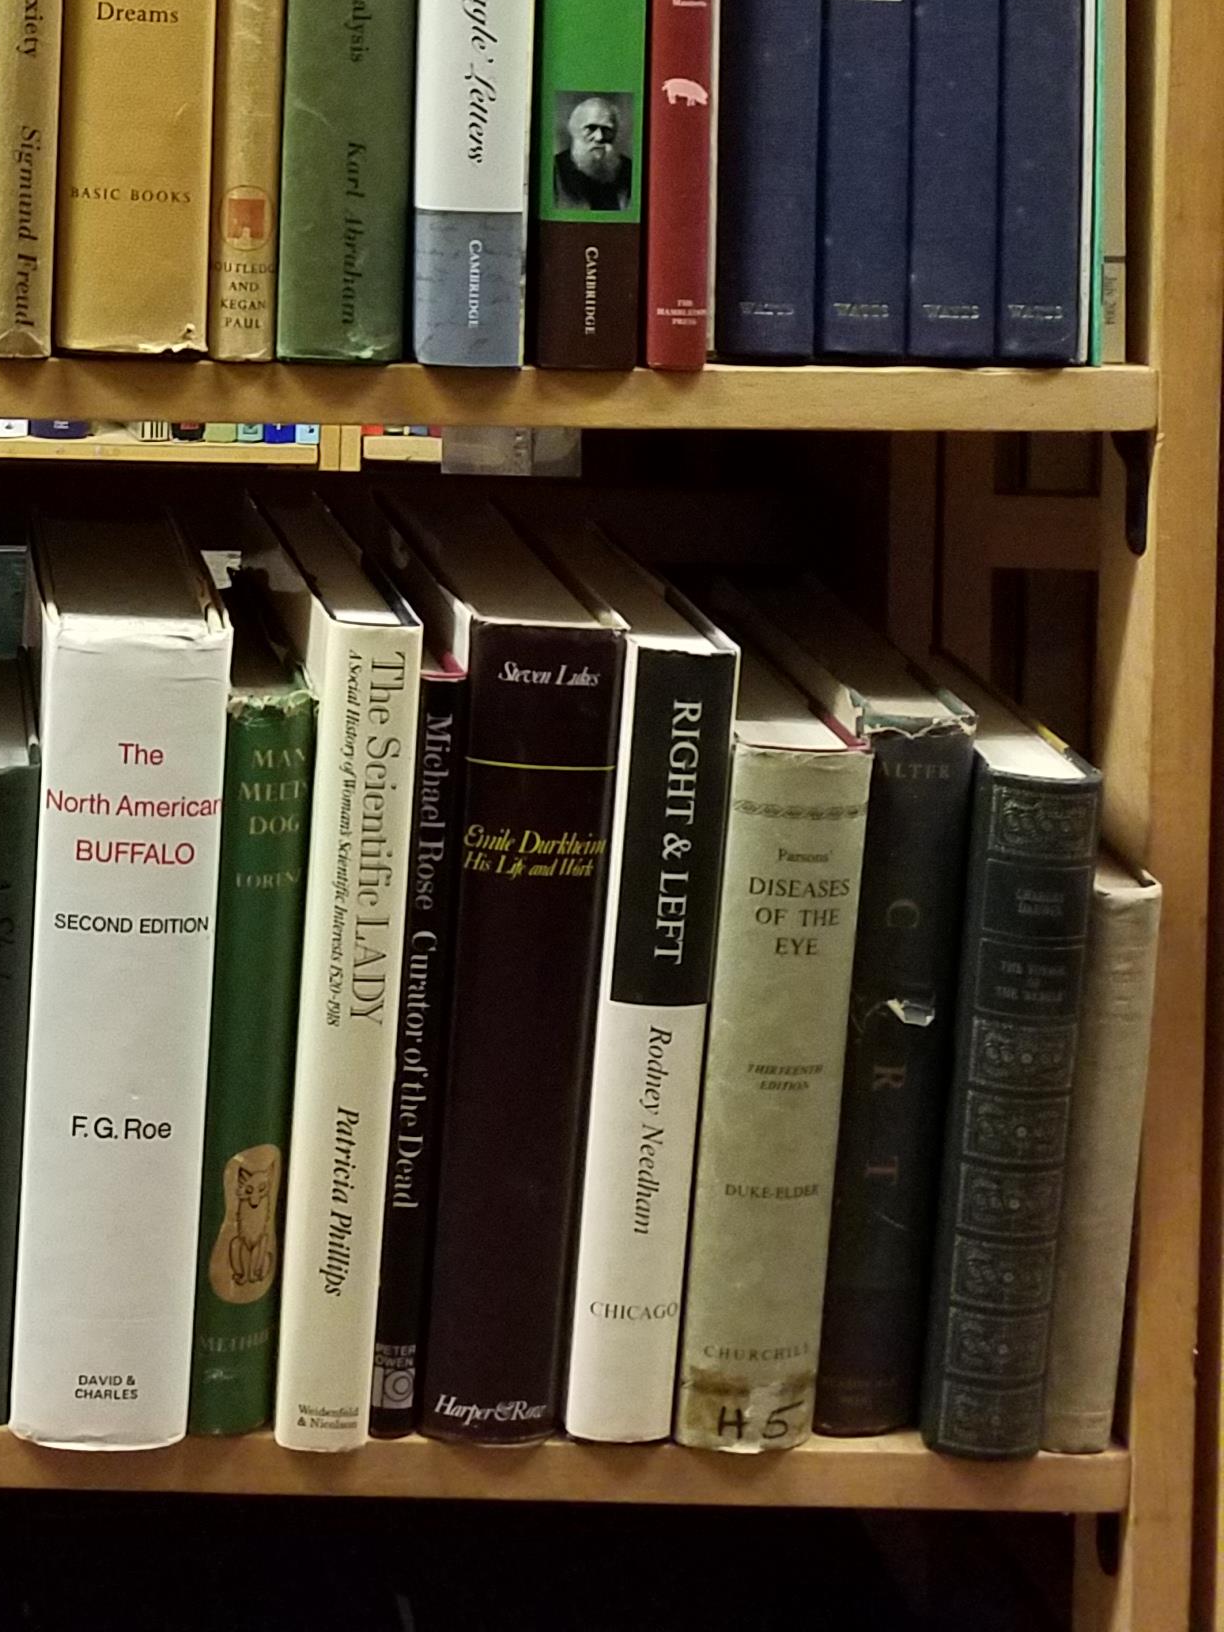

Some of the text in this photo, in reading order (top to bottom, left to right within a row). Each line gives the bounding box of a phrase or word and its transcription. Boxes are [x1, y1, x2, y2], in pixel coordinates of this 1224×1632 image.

[96, 0, 180, 25] Dreams
[118, 743, 164, 766] The
[46, 789, 111, 817] North
[348, 651, 406, 1027] The Scientific LADY
[652, 698, 703, 966] RIGHT & LEFT
[75, 839, 196, 866] BUFFALO
[748, 875, 851, 900] DISEASES
[54, 913, 210, 935] SECOND EDITION
[755, 906, 840, 928] OF THE
[774, 935, 819, 957] EYE
[392, 712, 454, 1208] Michael Rose Curator of the Dead
[124, 1117, 173, 1141] Roe
[633, 1025, 673, 1237] Rodney Needham
[319, 1105, 360, 1298] Patricia Phillips
[589, 1300, 679, 1322] CHICAGO
[78, 1375, 123, 1387] DAVID
[74, 1387, 138, 1401] CHARLES
